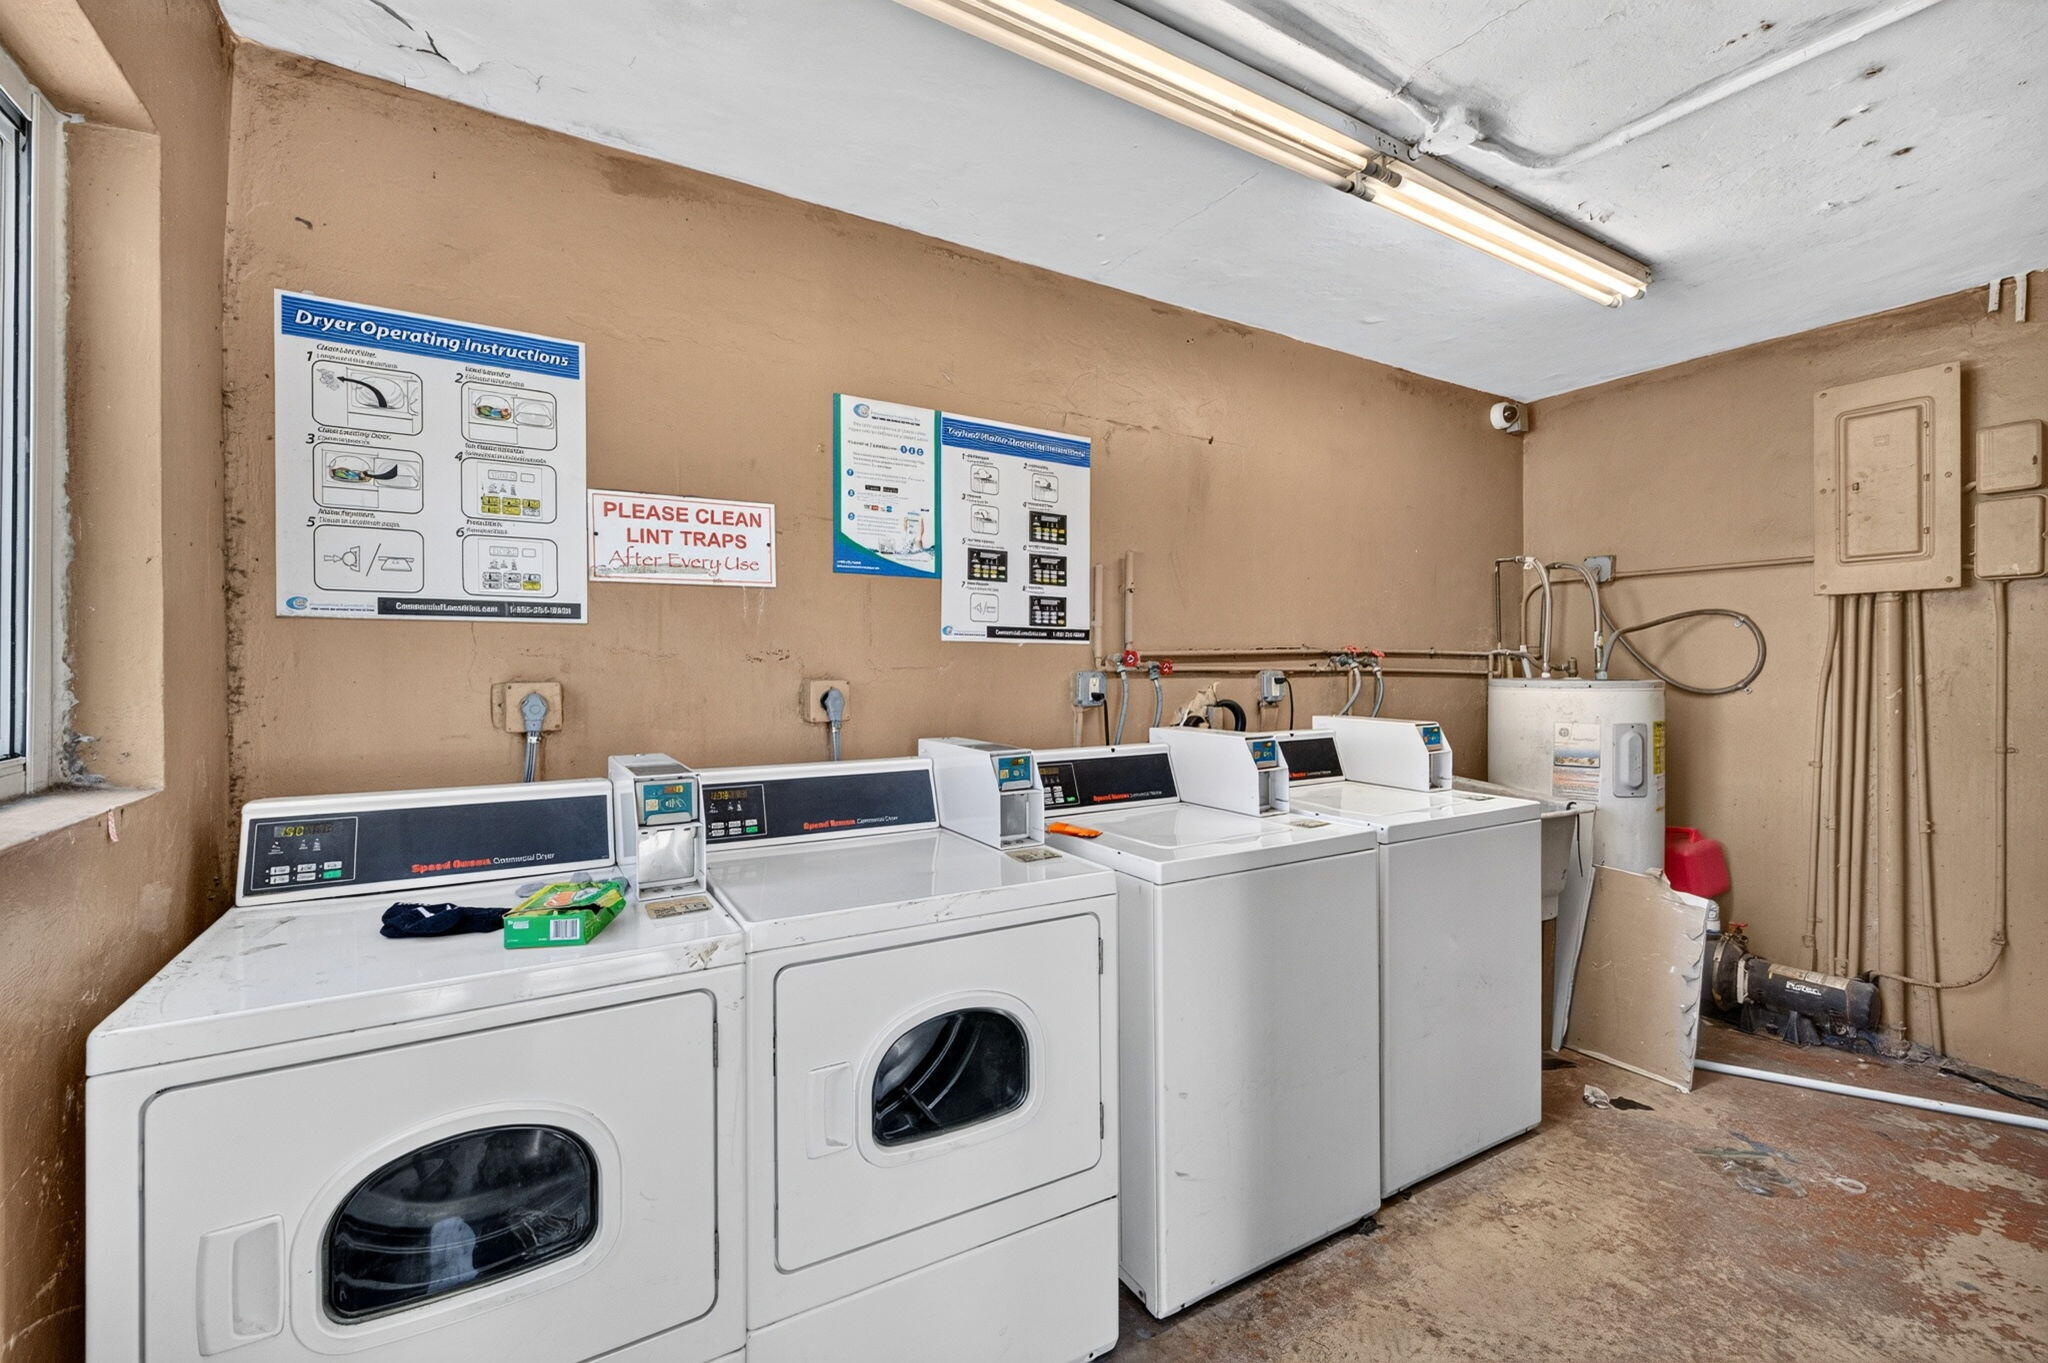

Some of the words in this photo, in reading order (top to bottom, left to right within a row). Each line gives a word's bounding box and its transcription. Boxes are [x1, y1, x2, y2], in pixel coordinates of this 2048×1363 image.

[295, 309, 356, 332] Dryer
[360, 321, 461, 351] Operating
[465, 338, 569, 366] Instructions
[306, 351, 313, 361] 1
[455, 373, 463, 383] 2
[306, 433, 315, 444] 3
[455, 452, 463, 461] 4
[603, 501, 689, 523] PLEASE
[695, 508, 762, 528] CLEAN
[306, 517, 315, 527] 5
[456, 527, 465, 537] 6
[626, 527, 674, 545] LINT
[680, 530, 747, 549] TRAPS
[609, 546, 662, 567] After
[668, 553, 722, 576] Every
[725, 556, 760, 571] Use
[411, 861, 451, 874] Speed
[453, 858, 491, 869] Queen
[536, 853, 555, 861] Dryer
